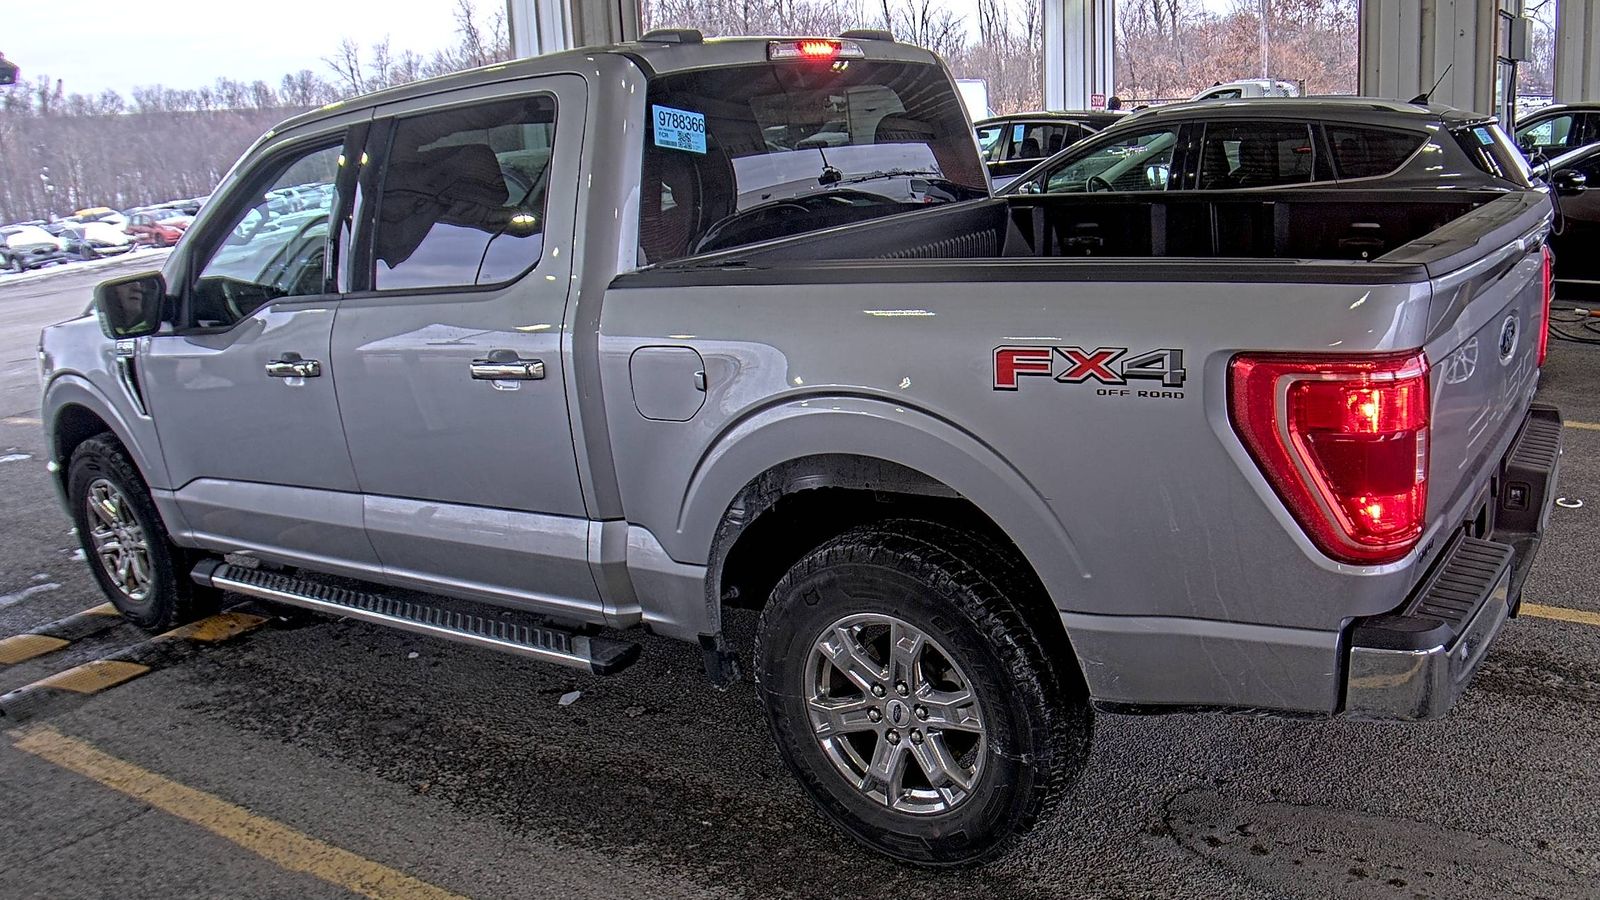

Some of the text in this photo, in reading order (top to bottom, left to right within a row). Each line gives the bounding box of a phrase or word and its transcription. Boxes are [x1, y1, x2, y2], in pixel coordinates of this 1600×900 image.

[1092, 95, 1104, 106] STOP
[658, 110, 705, 133] 9788366
[992, 345, 1187, 392] FX4
[1096, 388, 1185, 400] OFF ROAD
